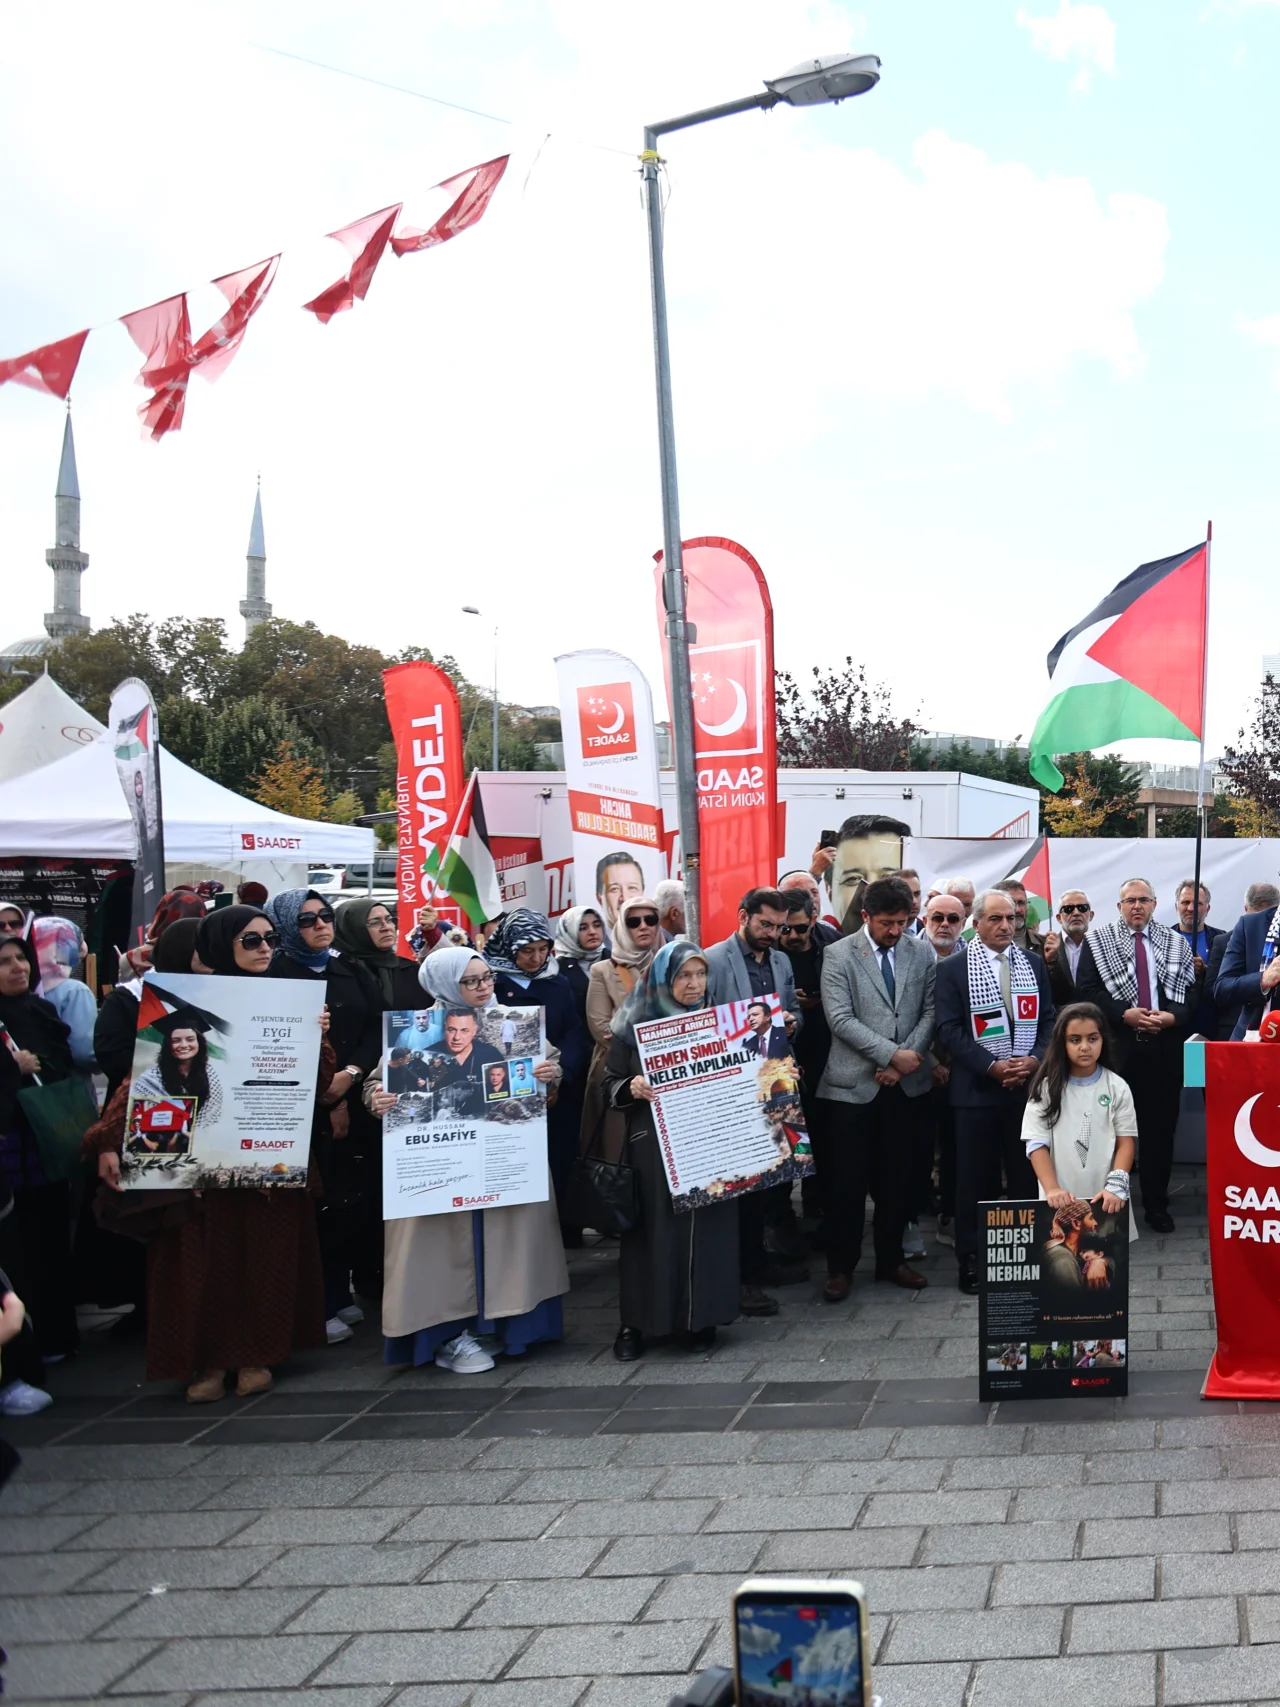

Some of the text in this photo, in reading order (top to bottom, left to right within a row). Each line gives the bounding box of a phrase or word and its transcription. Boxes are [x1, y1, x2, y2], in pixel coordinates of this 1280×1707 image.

[257, 836, 302, 849] SAADET
[250, 1016, 285, 1024] AYŞENUR
[262, 1027, 292, 1038] EYGİ
[640, 1017, 717, 1042] MAHMUT ARIKAN
[1265, 1021, 1279, 1039] 5
[644, 1037, 728, 1071] HEMEN ŞİMDİ!
[648, 1049, 757, 1086] NELER YAPILMALI?
[254, 1140, 295, 1149] SAADET
[405, 1129, 477, 1145] EBU SAFİYE
[464, 1194, 500, 1204] SAADET
[987, 1207, 1035, 1226] RİM VE
[987, 1225, 1034, 1245] DEDESİ
[987, 1244, 1027, 1263] HALİD
[987, 1265, 1040, 1282] NEBHAN
